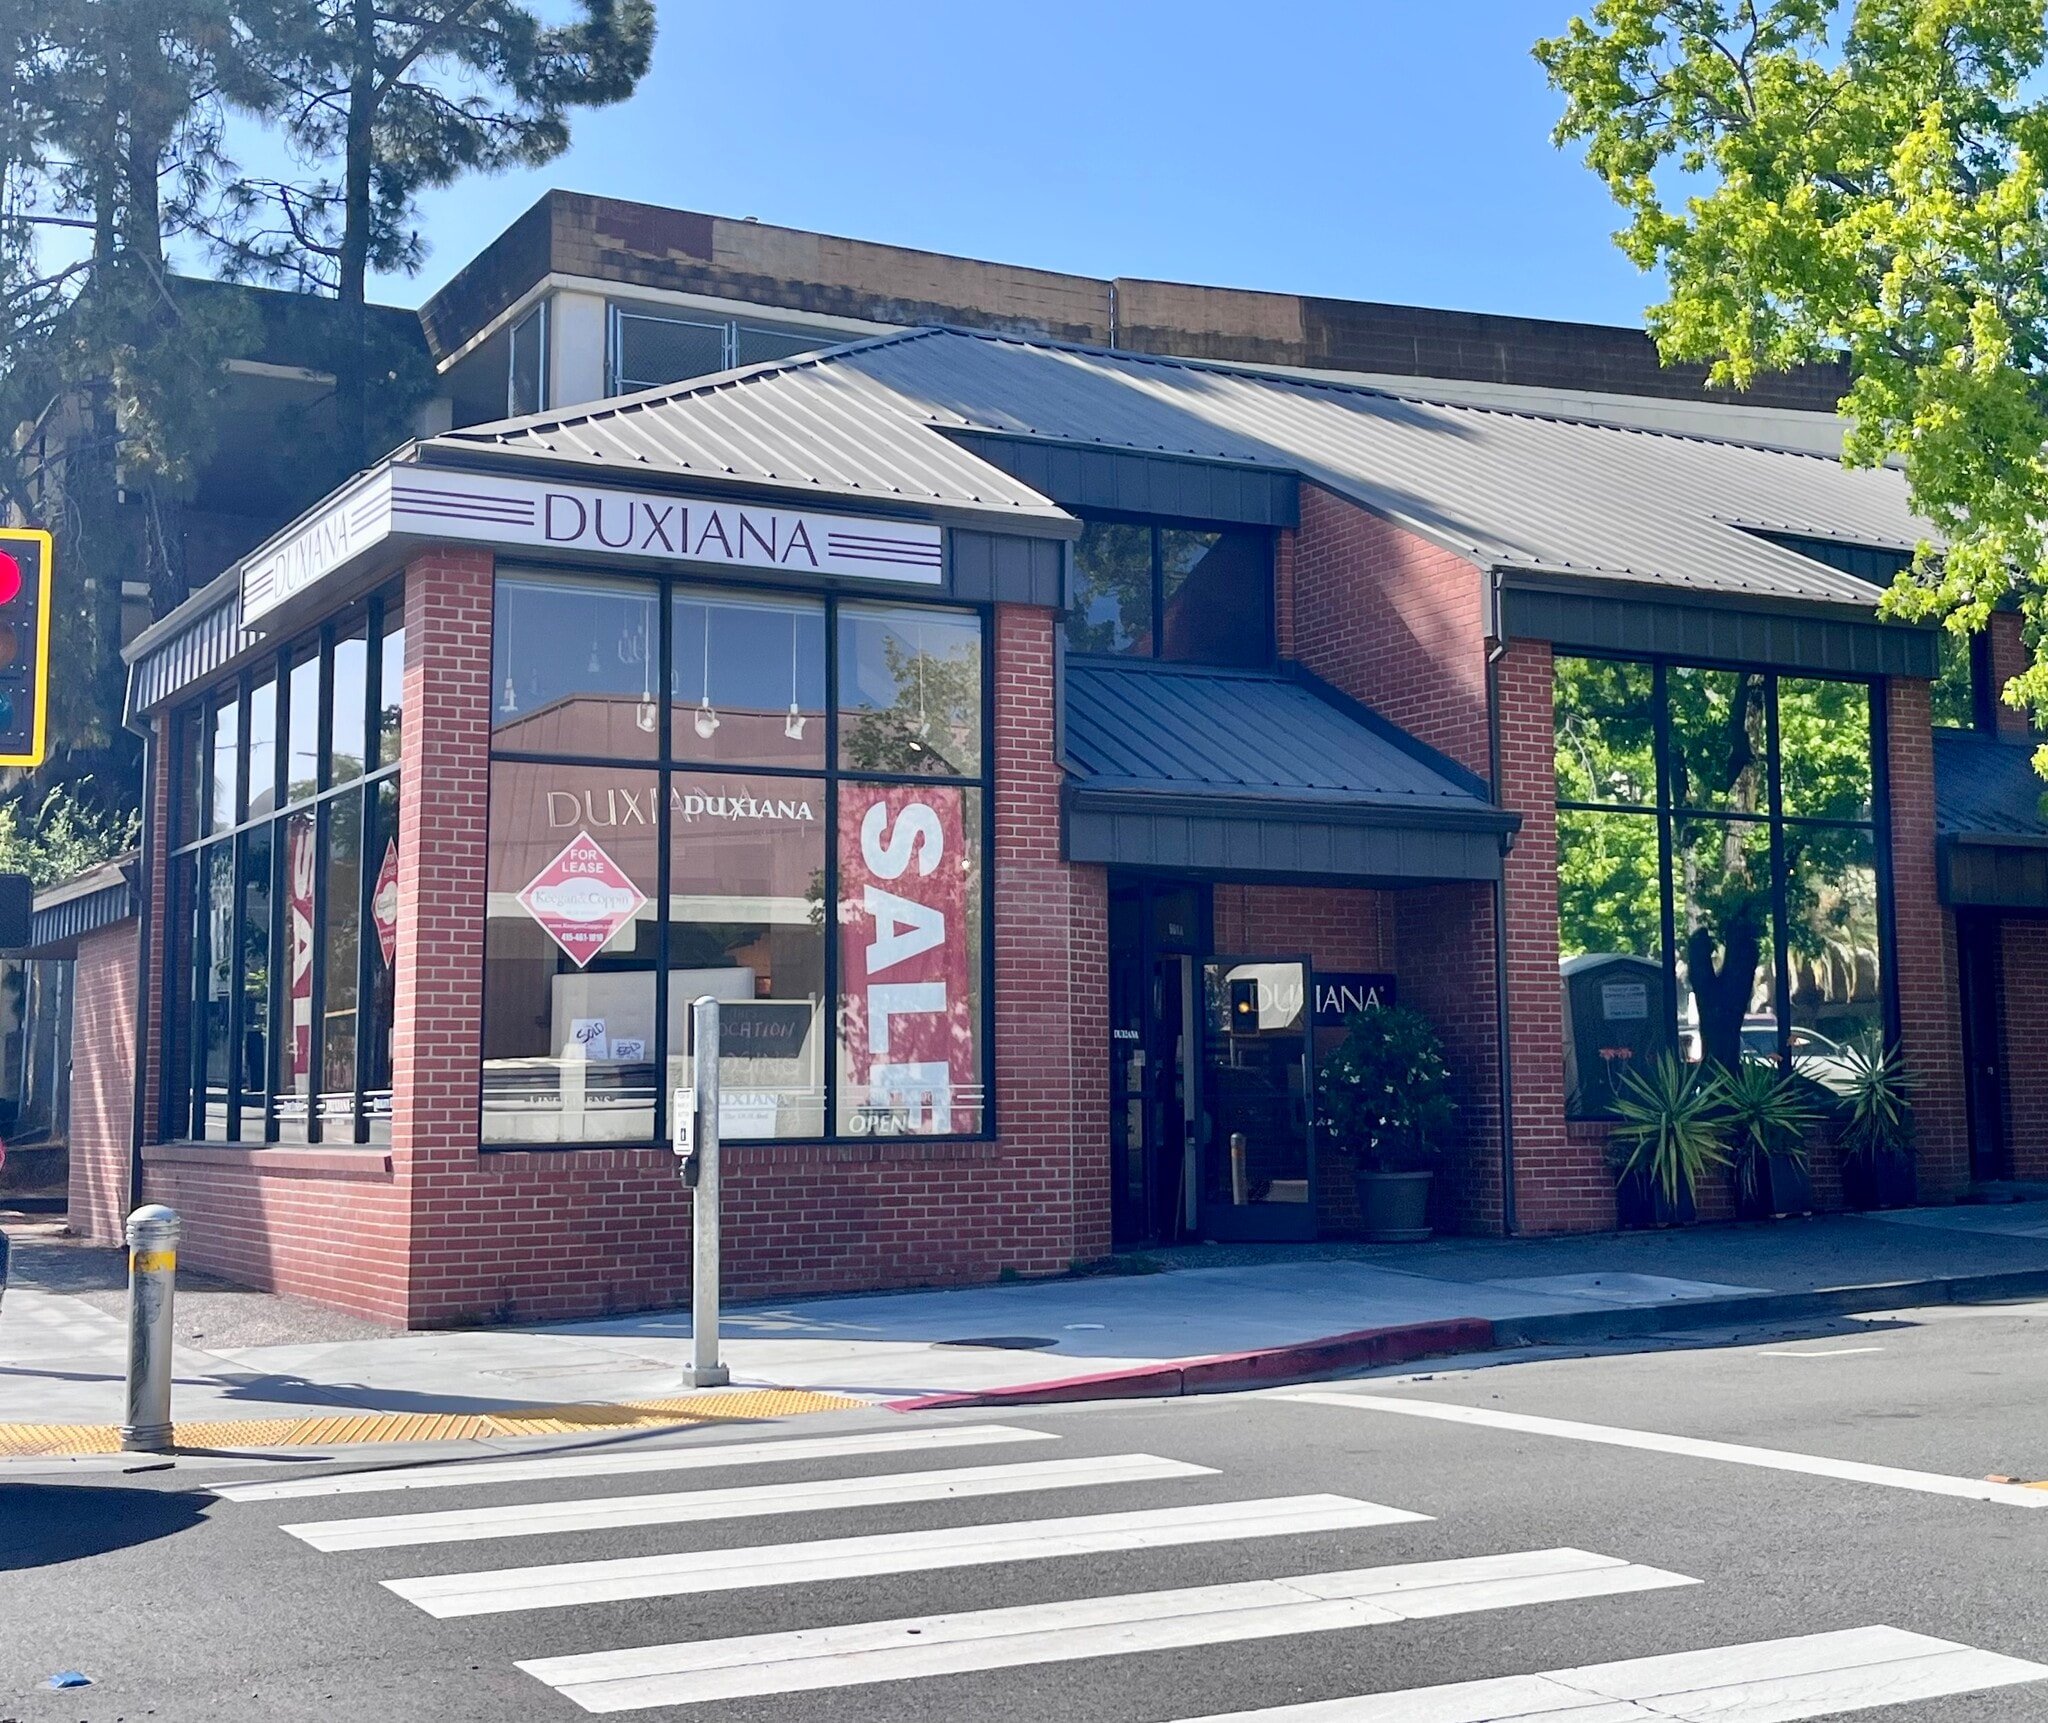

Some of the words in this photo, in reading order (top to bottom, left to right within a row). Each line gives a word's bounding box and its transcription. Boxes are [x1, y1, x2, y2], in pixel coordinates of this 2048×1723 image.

[545, 493, 819, 567] DUXIANA
[274, 509, 348, 601] DUXIANA
[684, 795, 814, 820] DUXIANA
[570, 849, 597, 860] FOR
[561, 862, 604, 873] LEASE
[859, 800, 952, 1134] SALE
[576, 1022, 605, 1044] SOLD
[718, 1022, 796, 1037] OCATION
[718, 1094, 789, 1107] UXIANA
[848, 1114, 907, 1133] OPEN
